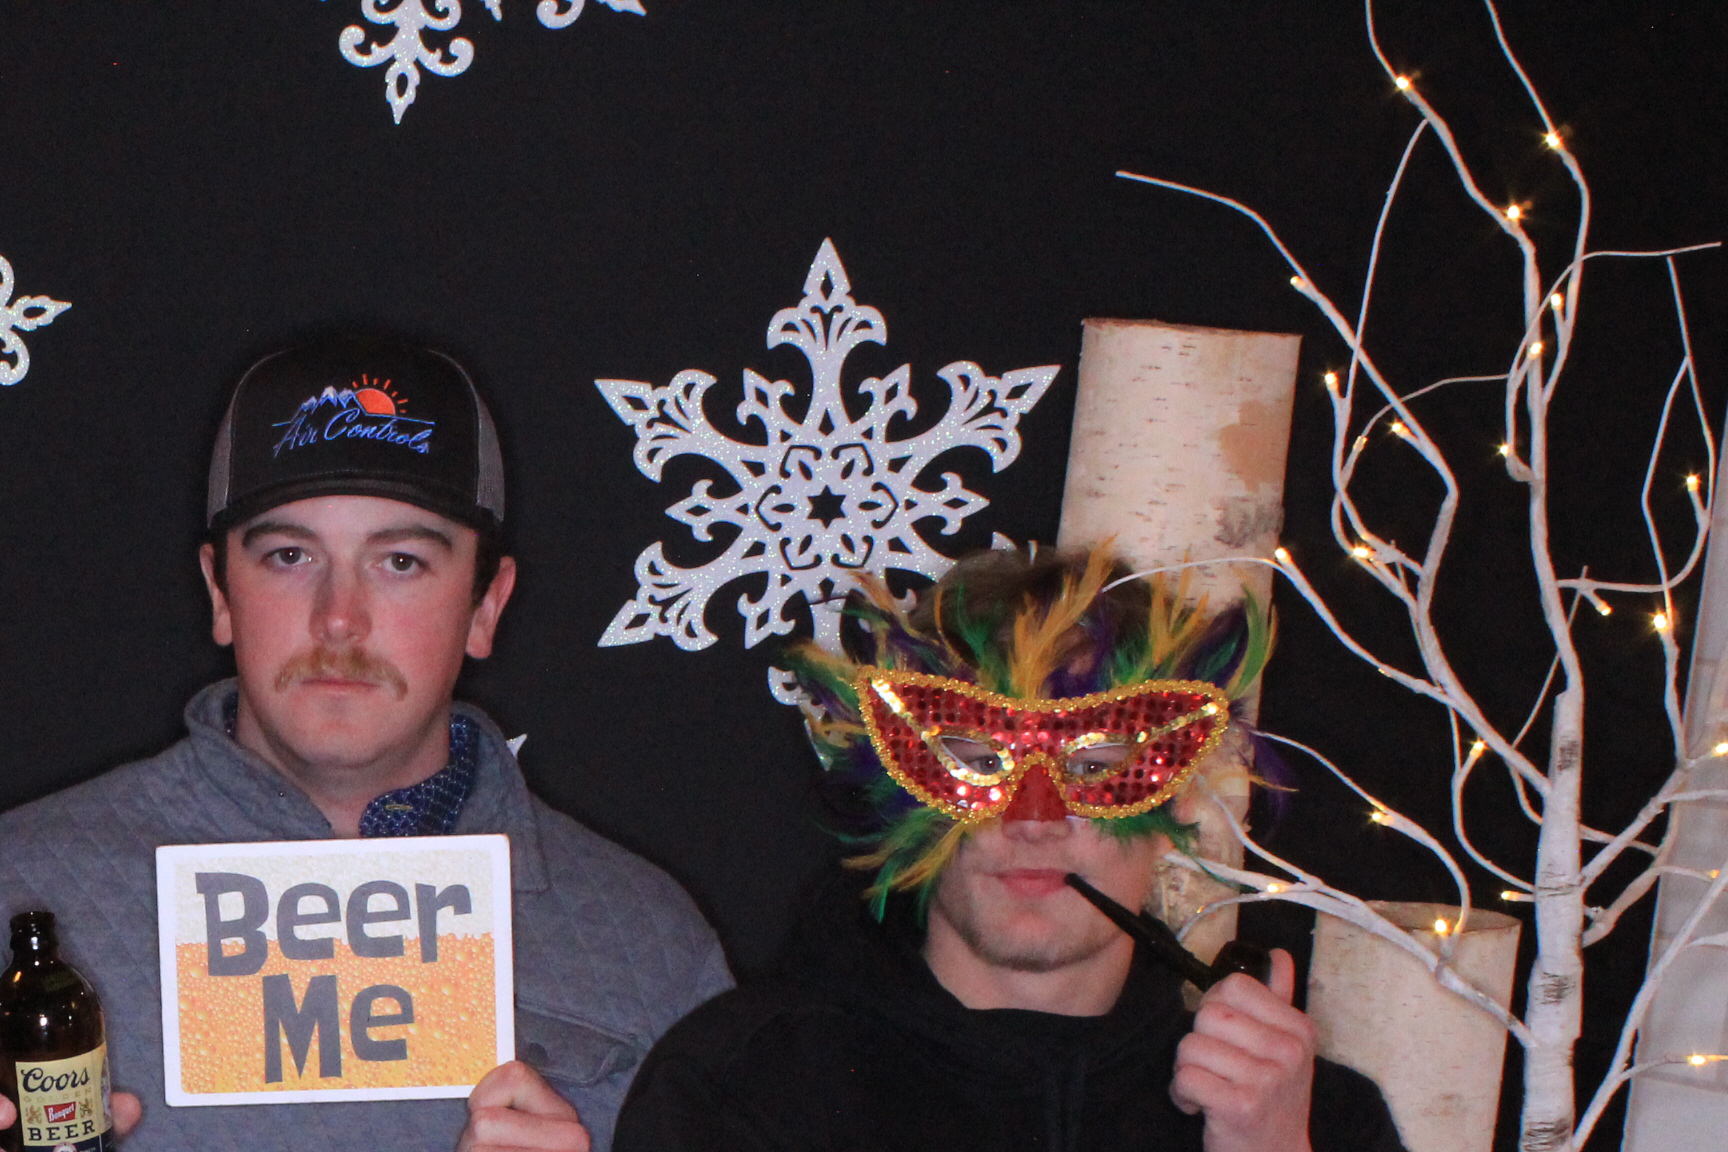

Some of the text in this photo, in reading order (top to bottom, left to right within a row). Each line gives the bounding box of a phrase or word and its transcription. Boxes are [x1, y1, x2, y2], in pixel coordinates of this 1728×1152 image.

[272, 407, 433, 458] Air Controls
[194, 871, 472, 977] Beer
[261, 973, 415, 1084] Me
[21, 1067, 91, 1093] Coors
[27, 1119, 96, 1141] BEER
